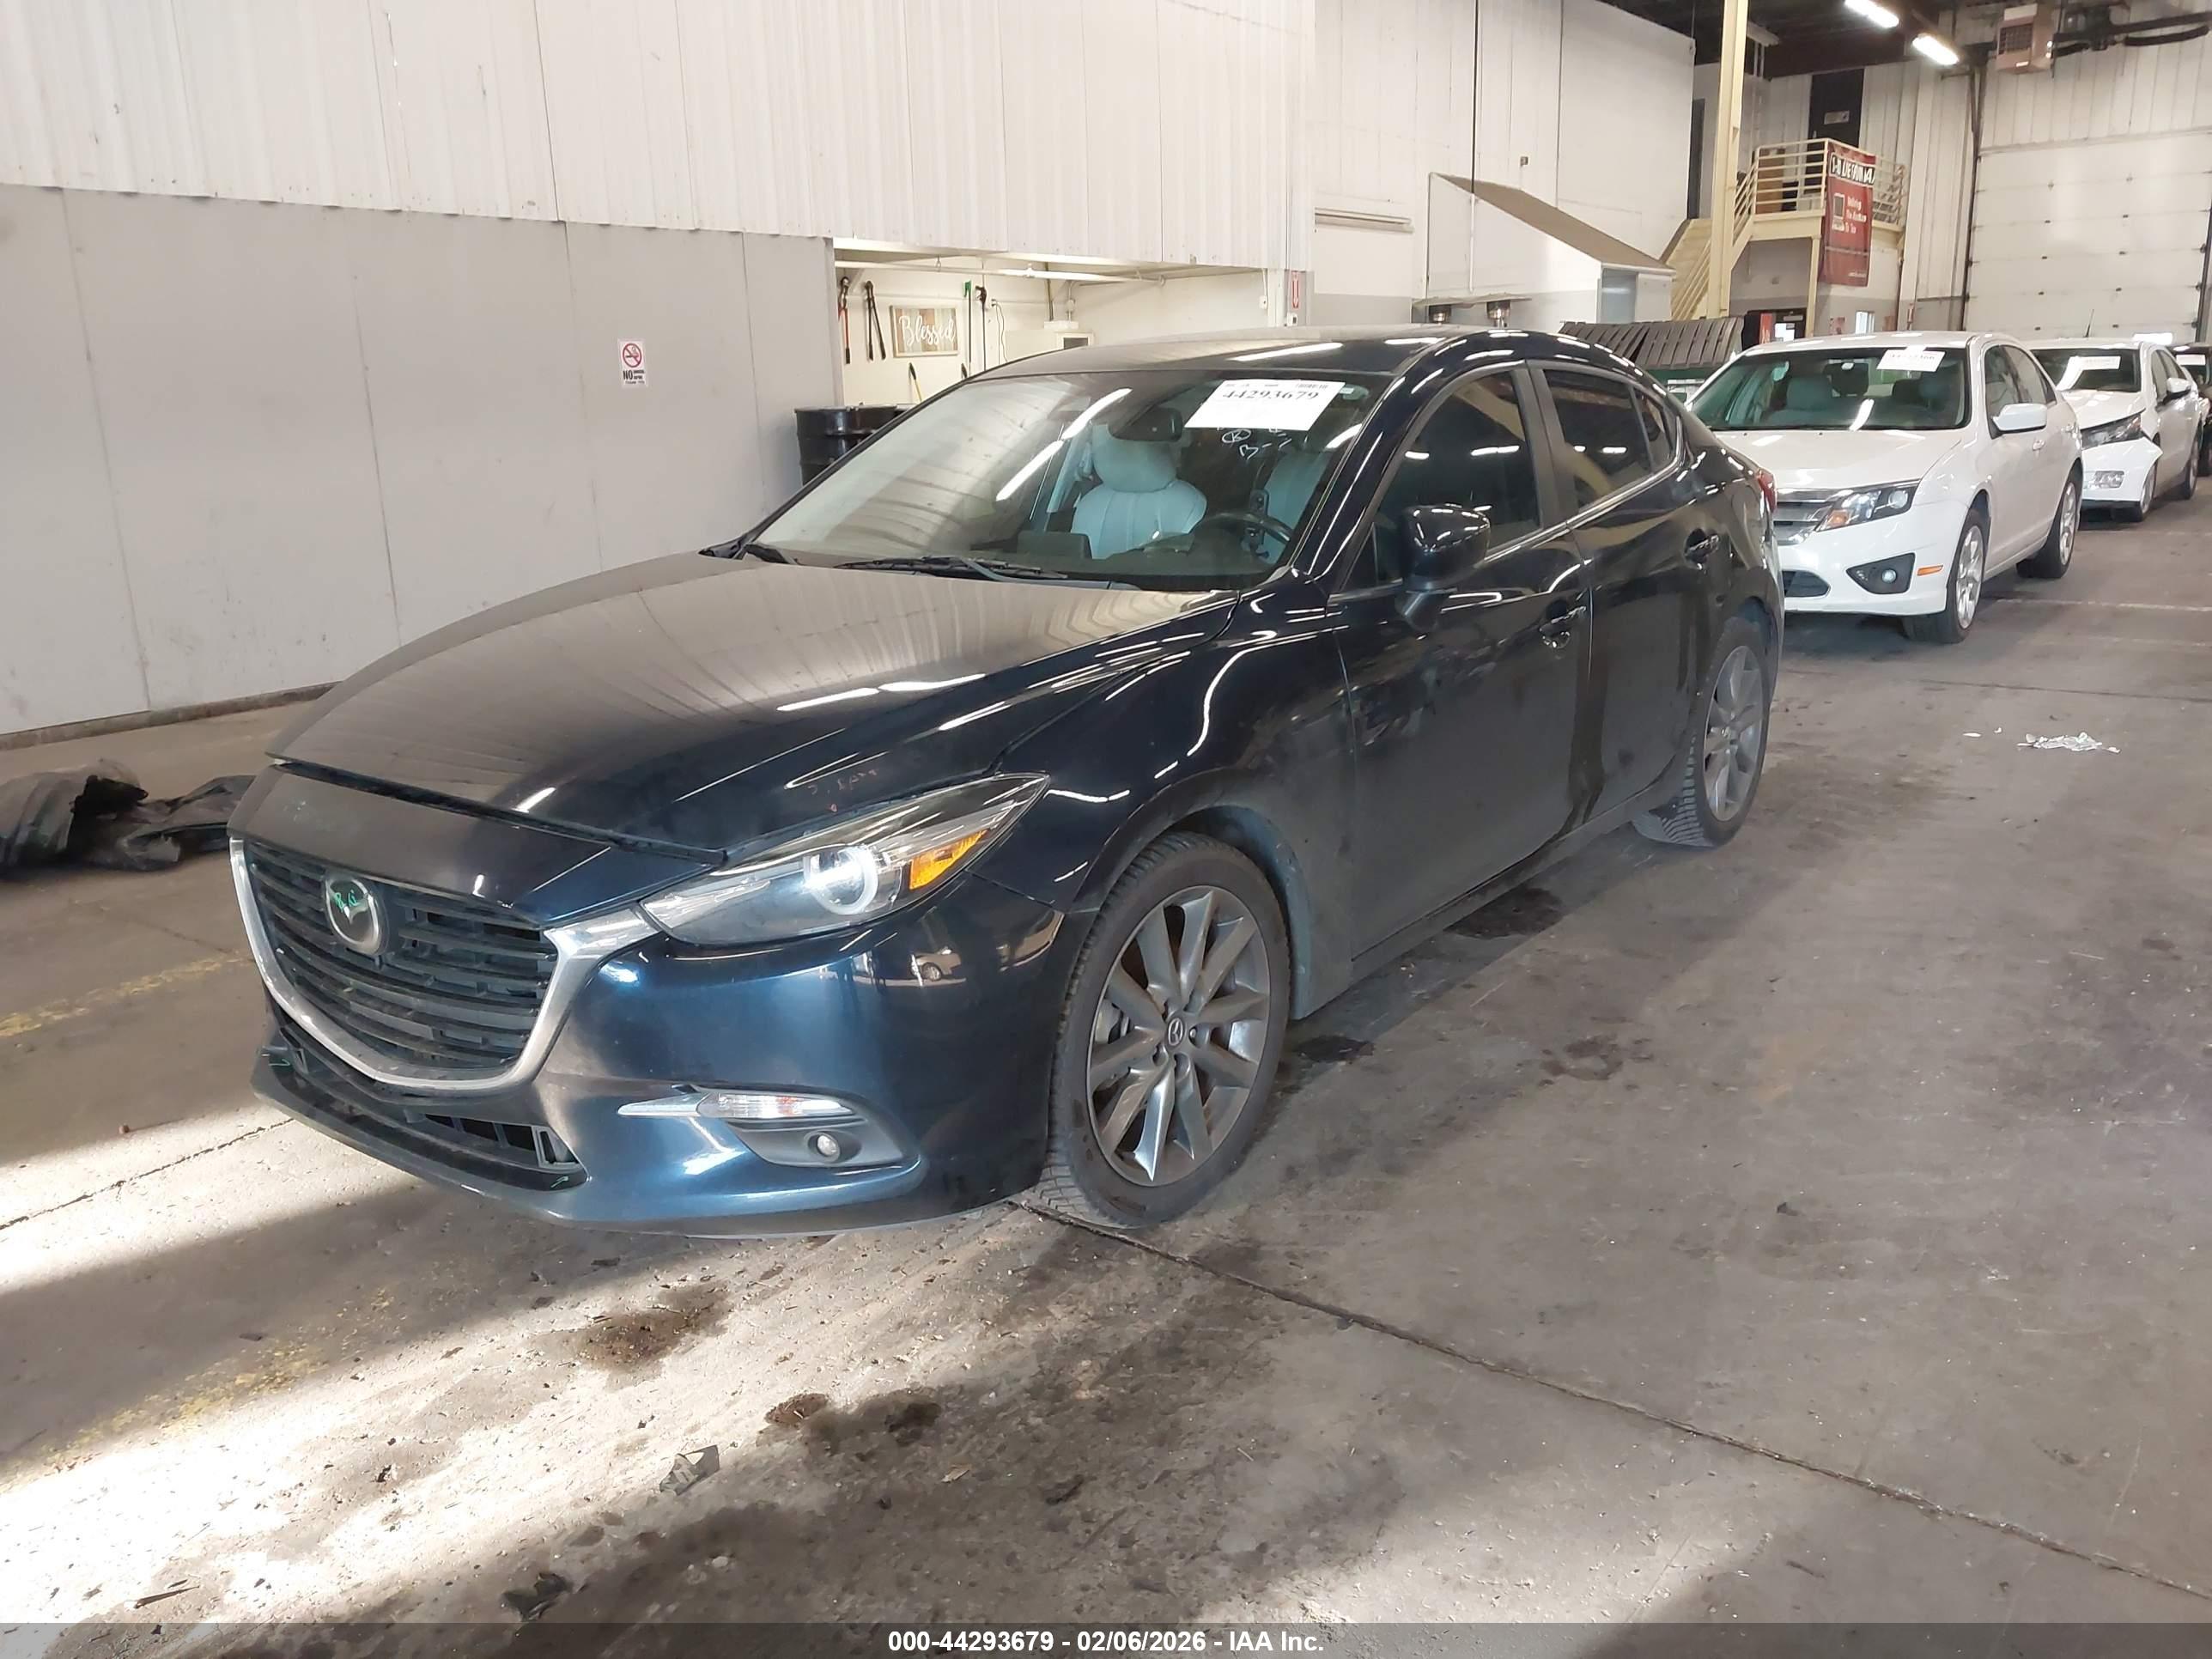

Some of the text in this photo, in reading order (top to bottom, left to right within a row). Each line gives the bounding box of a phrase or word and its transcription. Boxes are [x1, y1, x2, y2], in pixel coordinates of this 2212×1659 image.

[898, 314, 956, 347] Blessed
[623, 369, 633, 380] NO
[1222, 389, 1320, 400] 44293679
